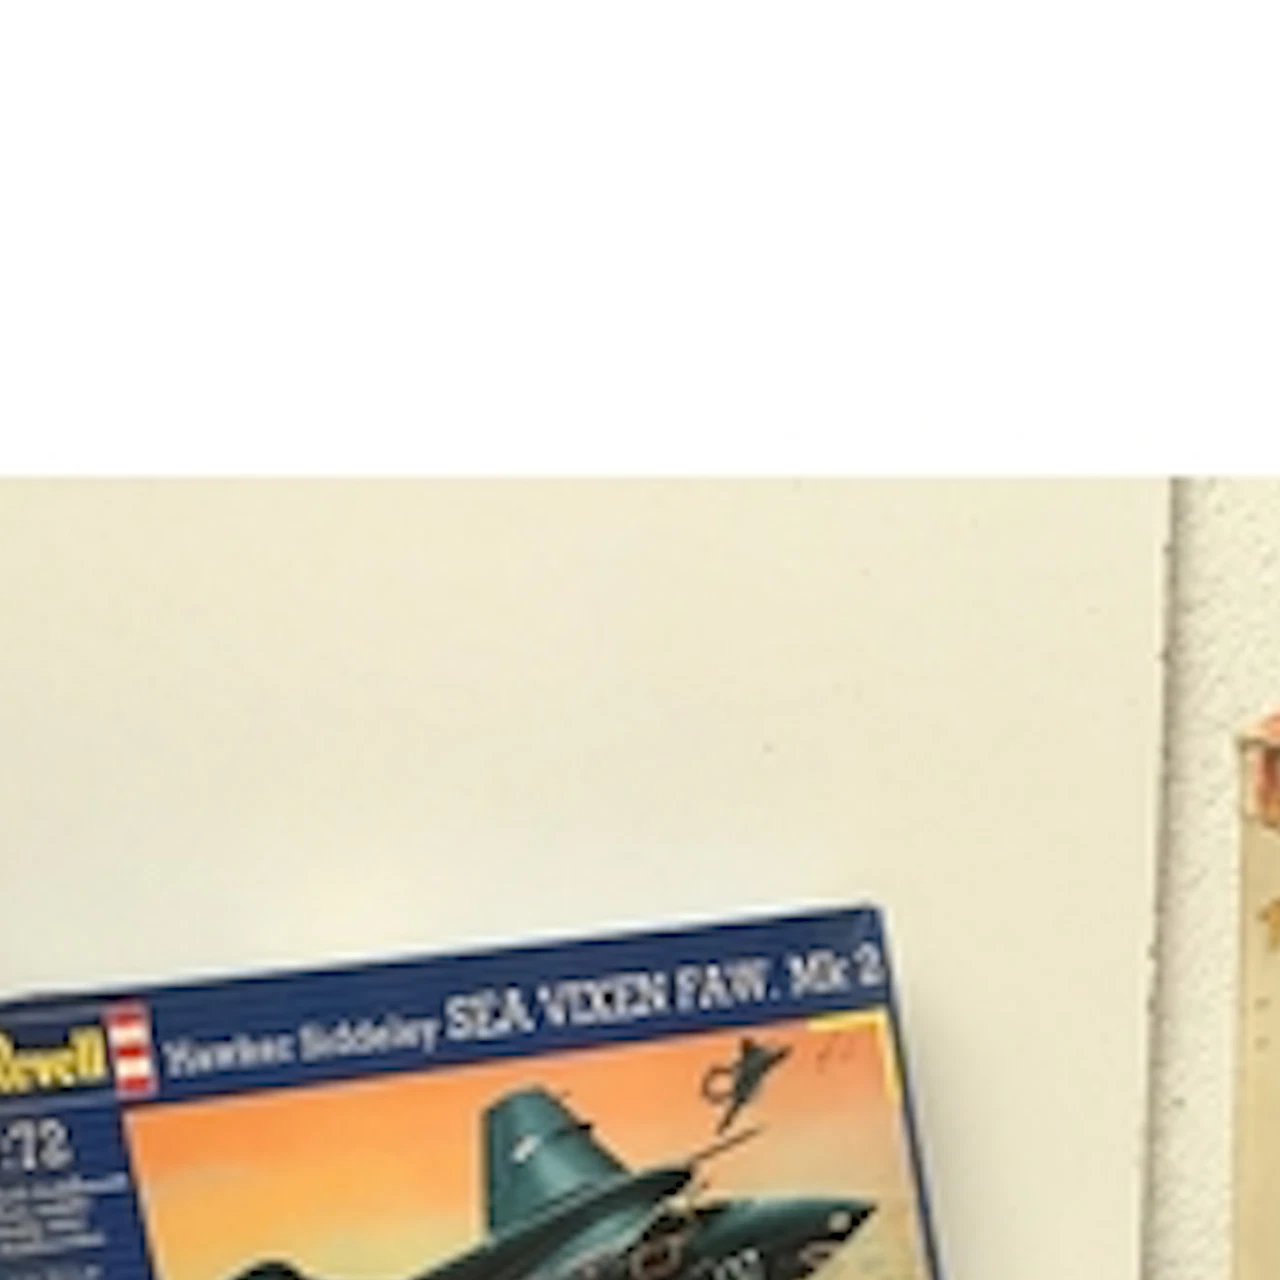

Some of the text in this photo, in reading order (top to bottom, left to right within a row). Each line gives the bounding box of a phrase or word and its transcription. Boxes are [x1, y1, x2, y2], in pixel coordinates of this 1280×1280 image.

[443, 987, 536, 1042] SEA
[536, 967, 670, 1029] VIXEN
[852, 939, 888, 990] 2
